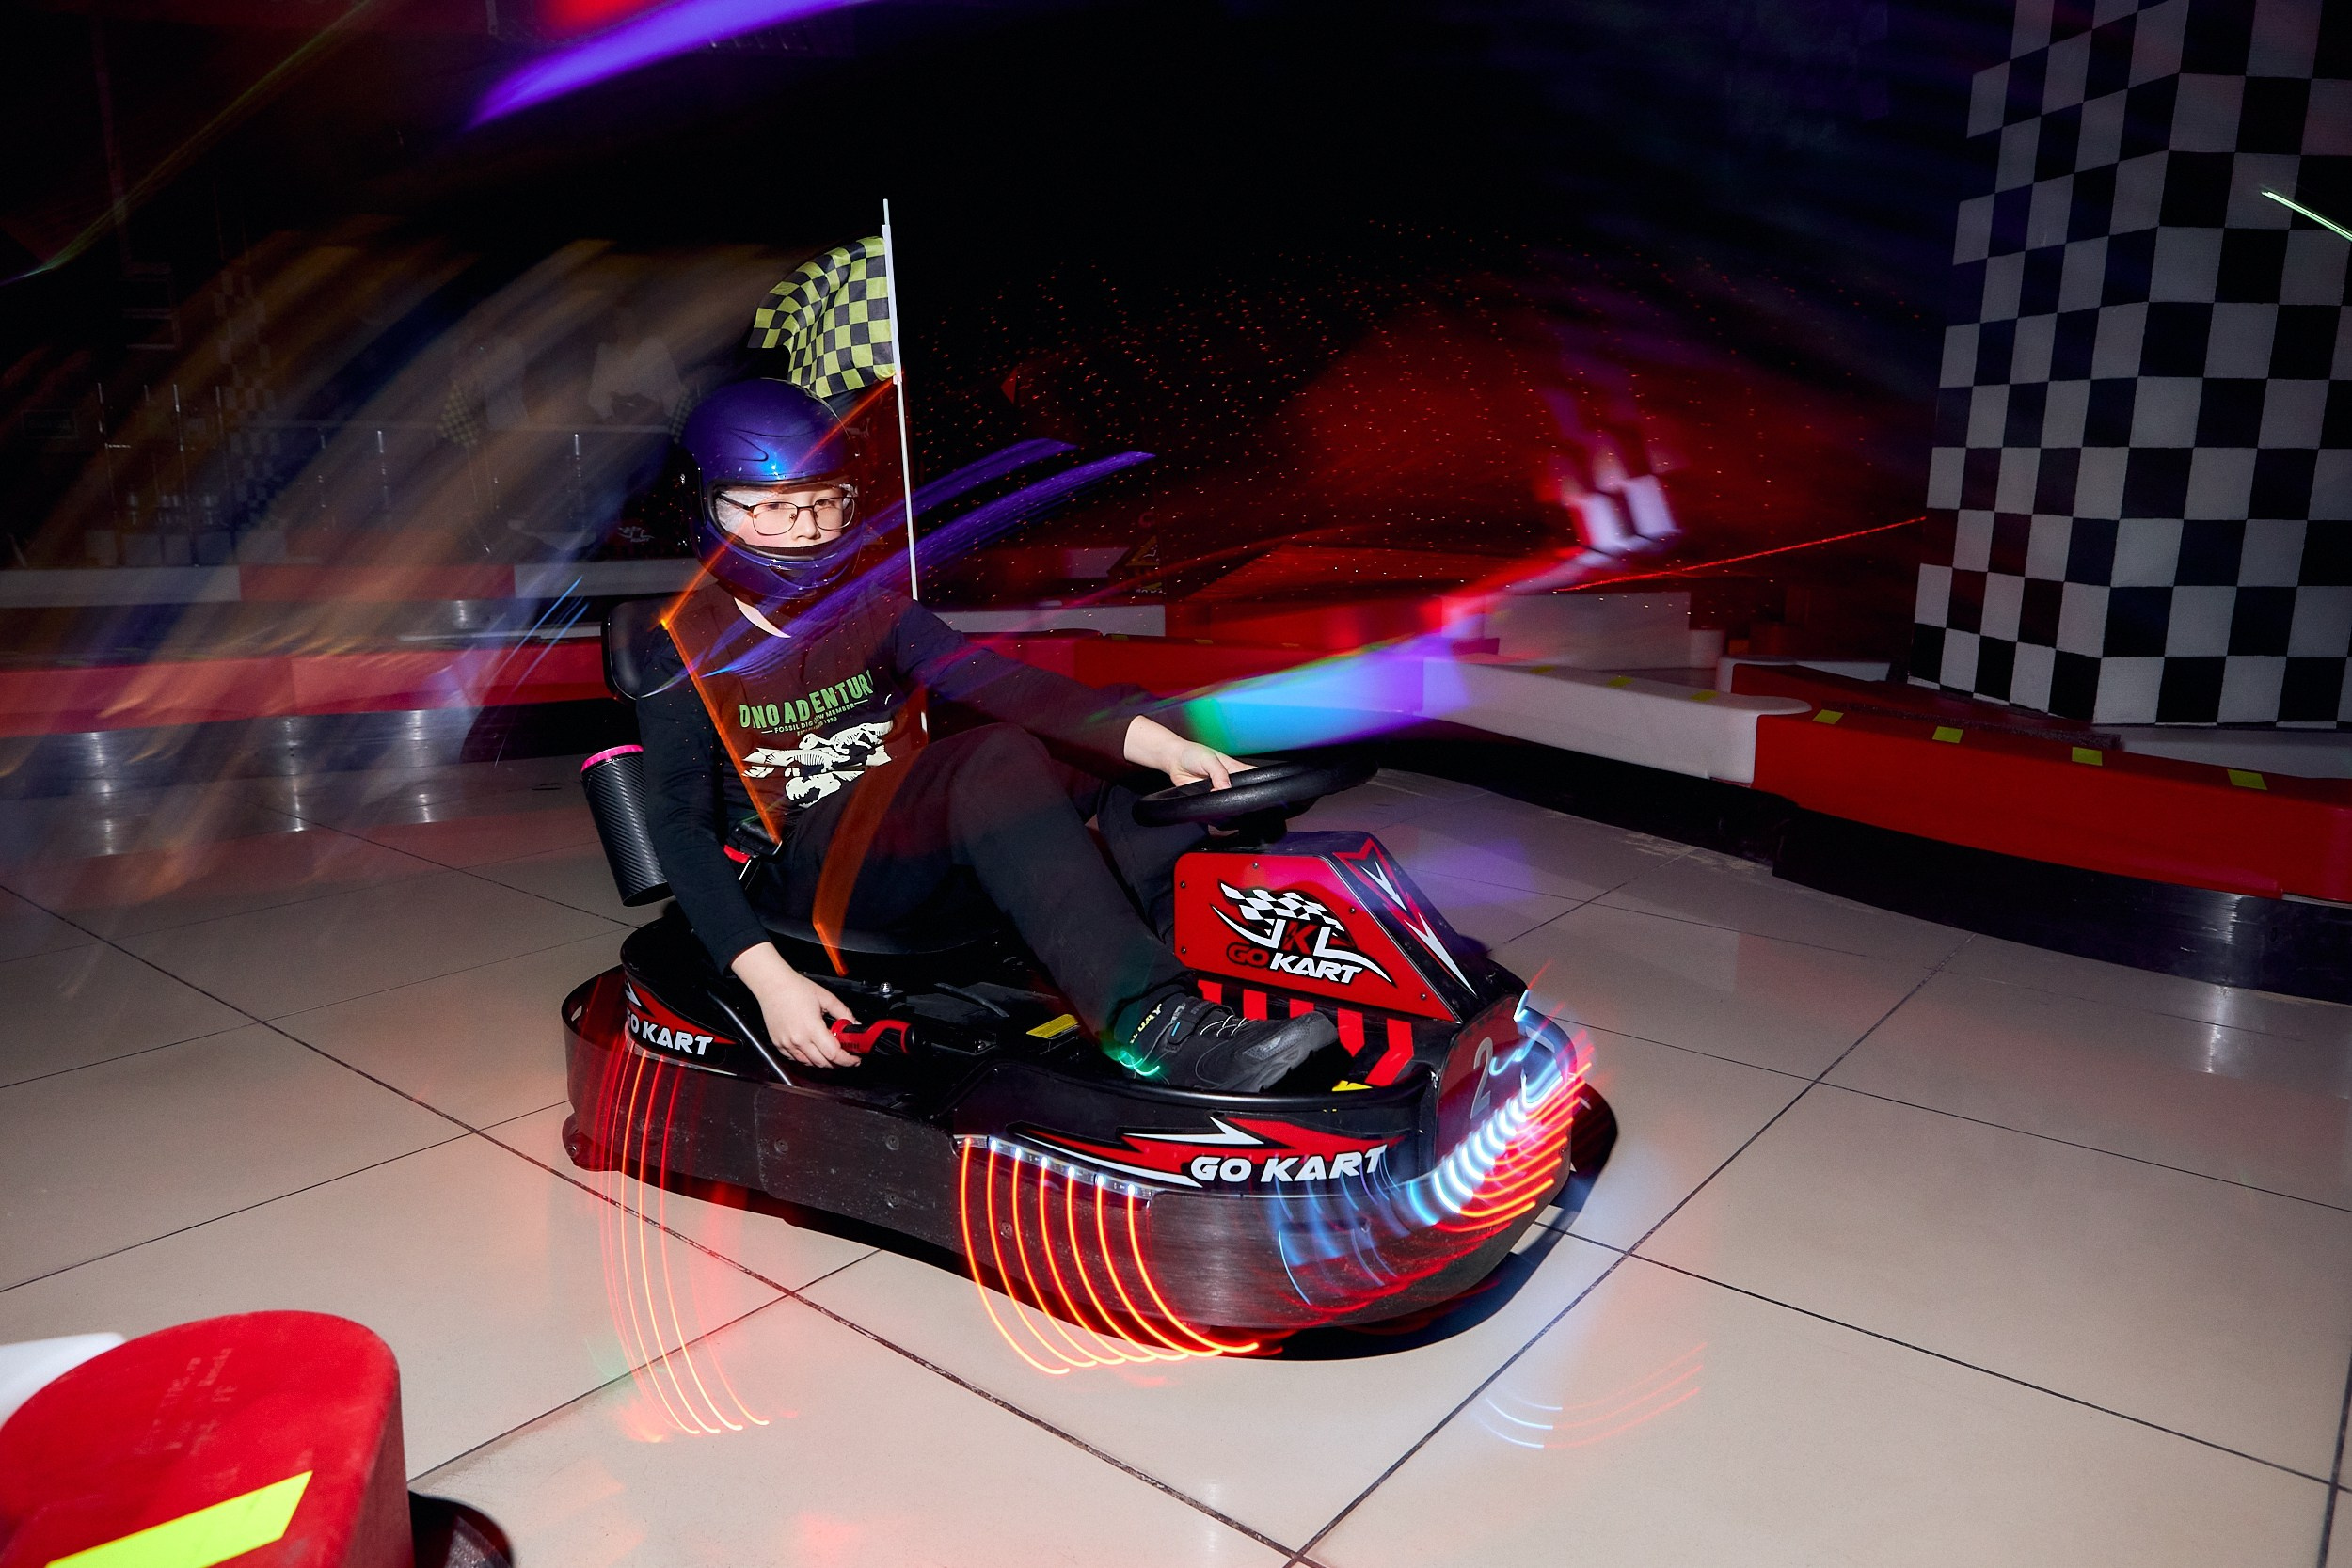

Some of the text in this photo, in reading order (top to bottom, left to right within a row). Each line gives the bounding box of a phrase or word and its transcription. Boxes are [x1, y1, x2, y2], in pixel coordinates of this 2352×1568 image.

[774, 723, 800, 734] FOSSIL
[801, 721, 814, 729] DIG
[826, 703, 855, 718] MEMBER
[643, 1021, 713, 1055] KART
[1470, 1037, 1494, 1119] 2
[1191, 1144, 1388, 1182] GO KART
